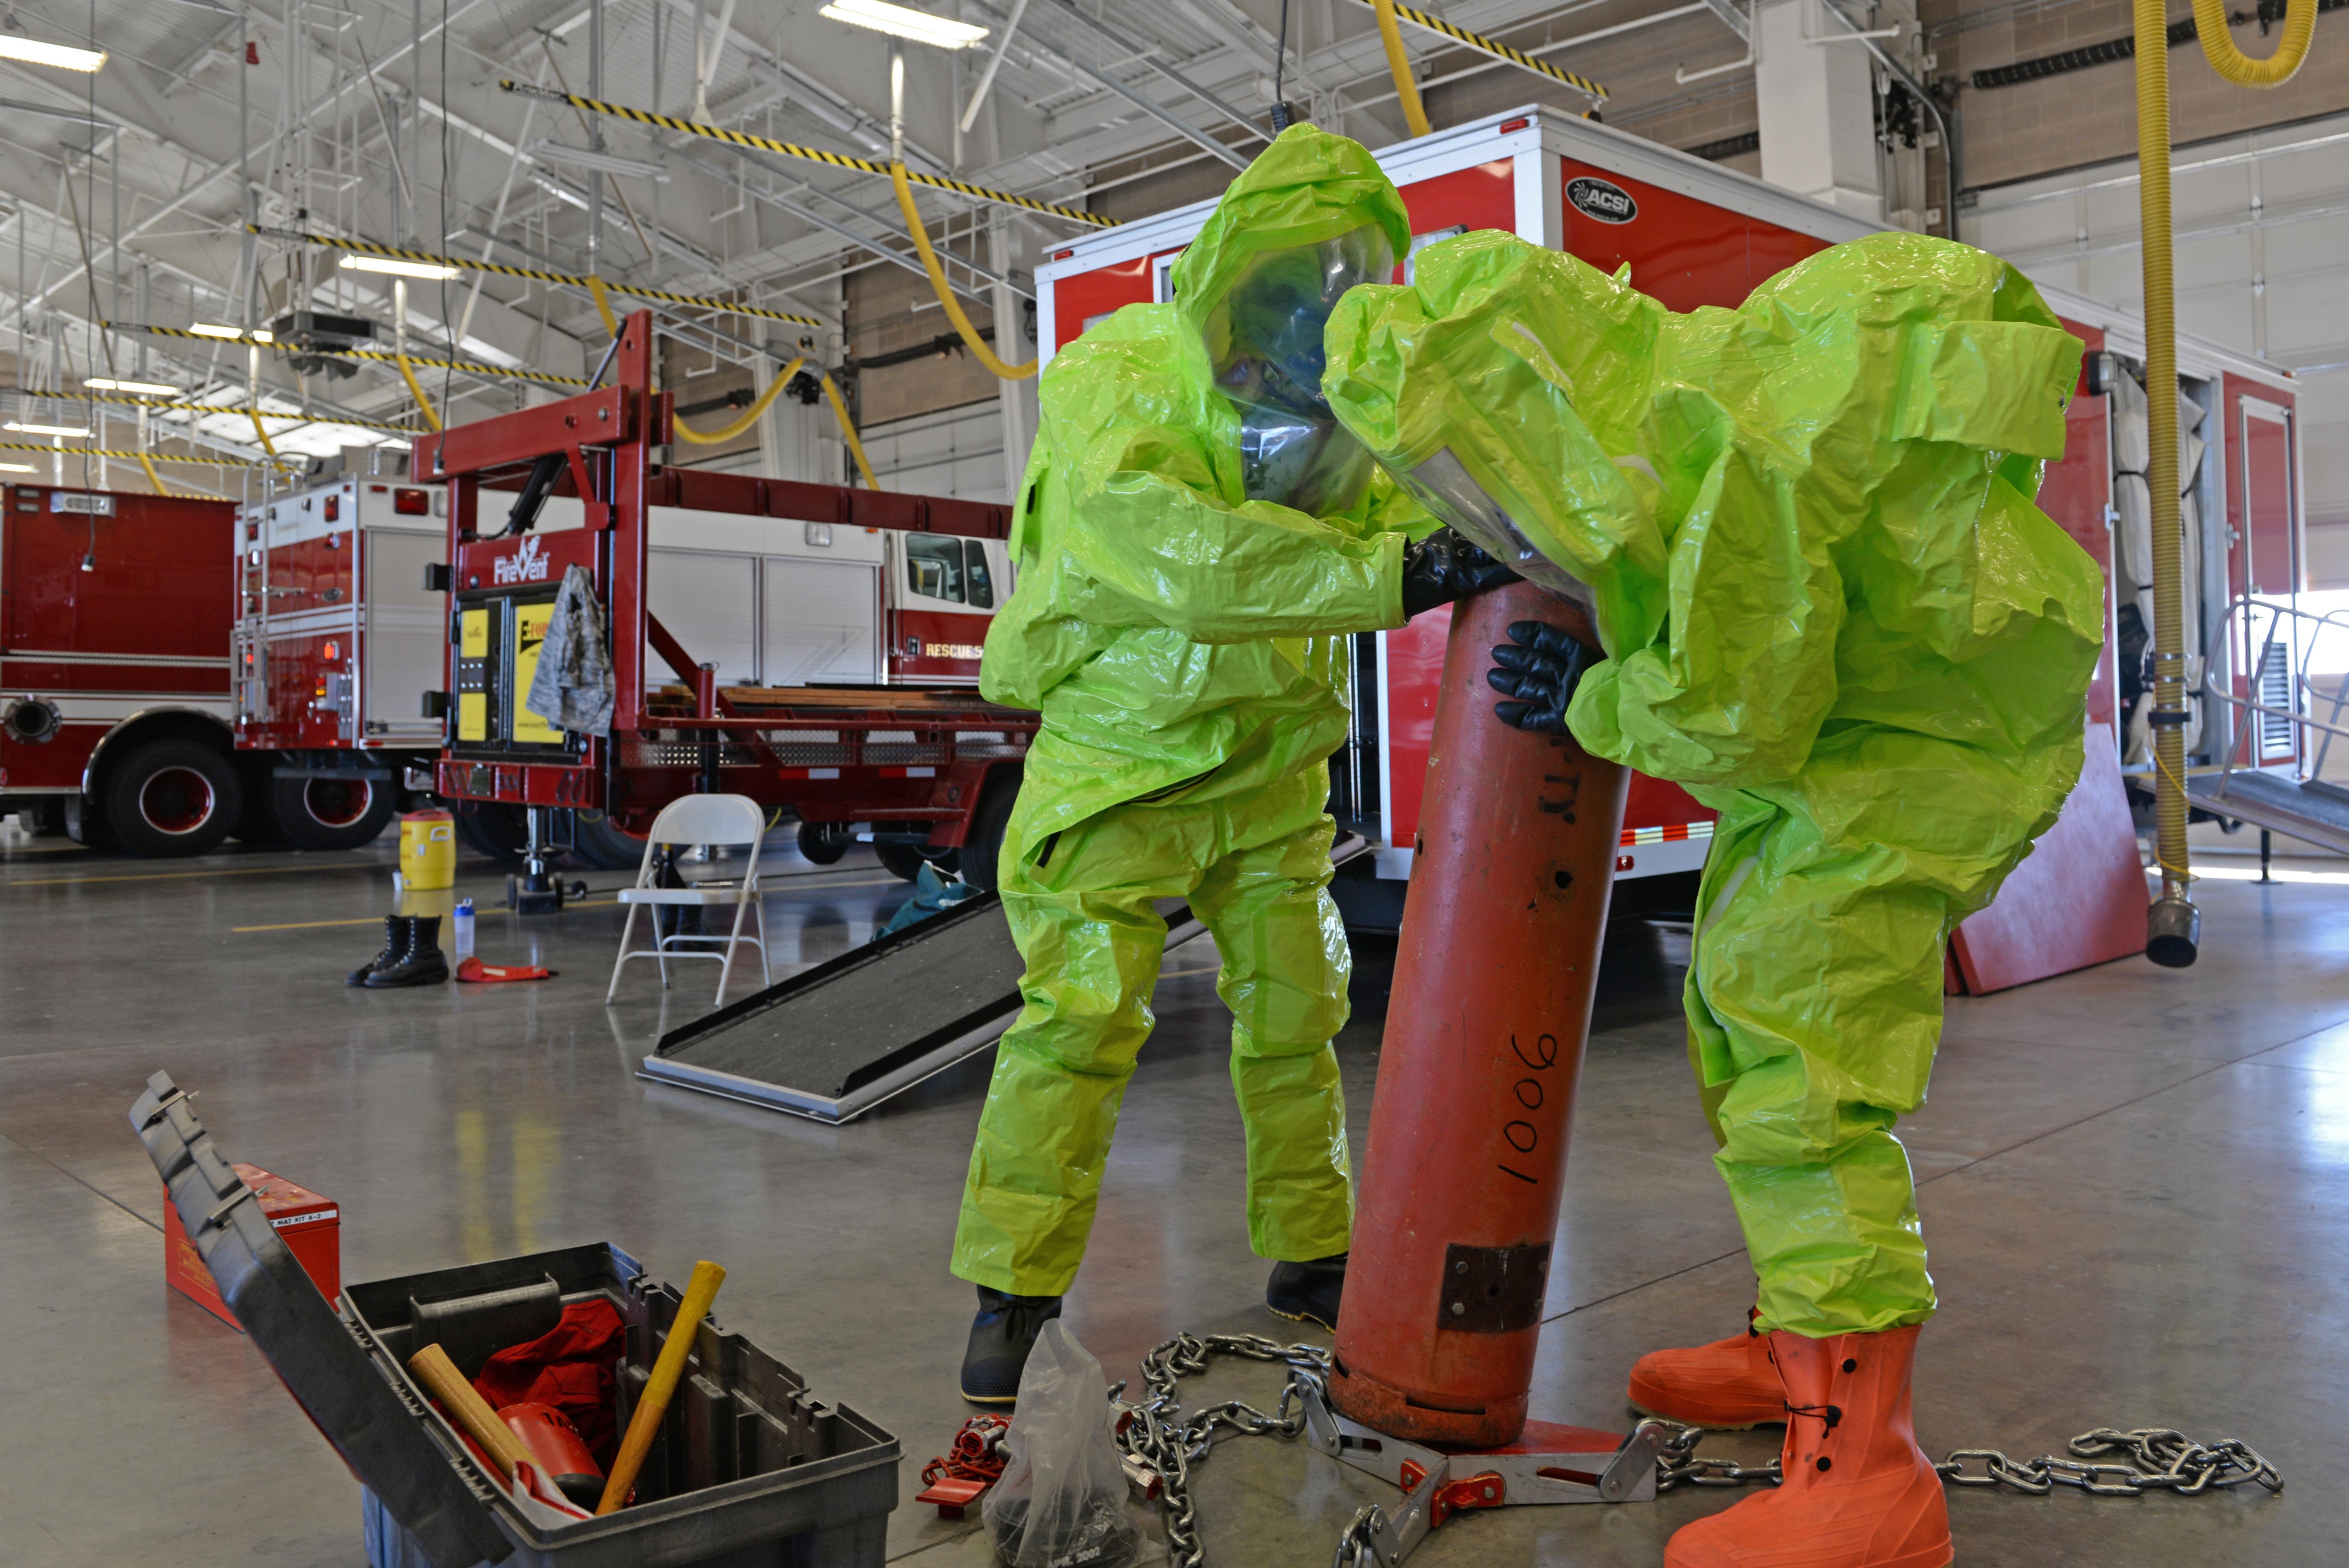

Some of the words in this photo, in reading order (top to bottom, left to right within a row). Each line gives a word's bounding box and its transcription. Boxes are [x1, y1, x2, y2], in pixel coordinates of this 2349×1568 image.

[1587, 188, 1630, 213] ACSI
[926, 644, 973, 659] RESCUE
[1498, 1034, 1557, 1185] 1006
